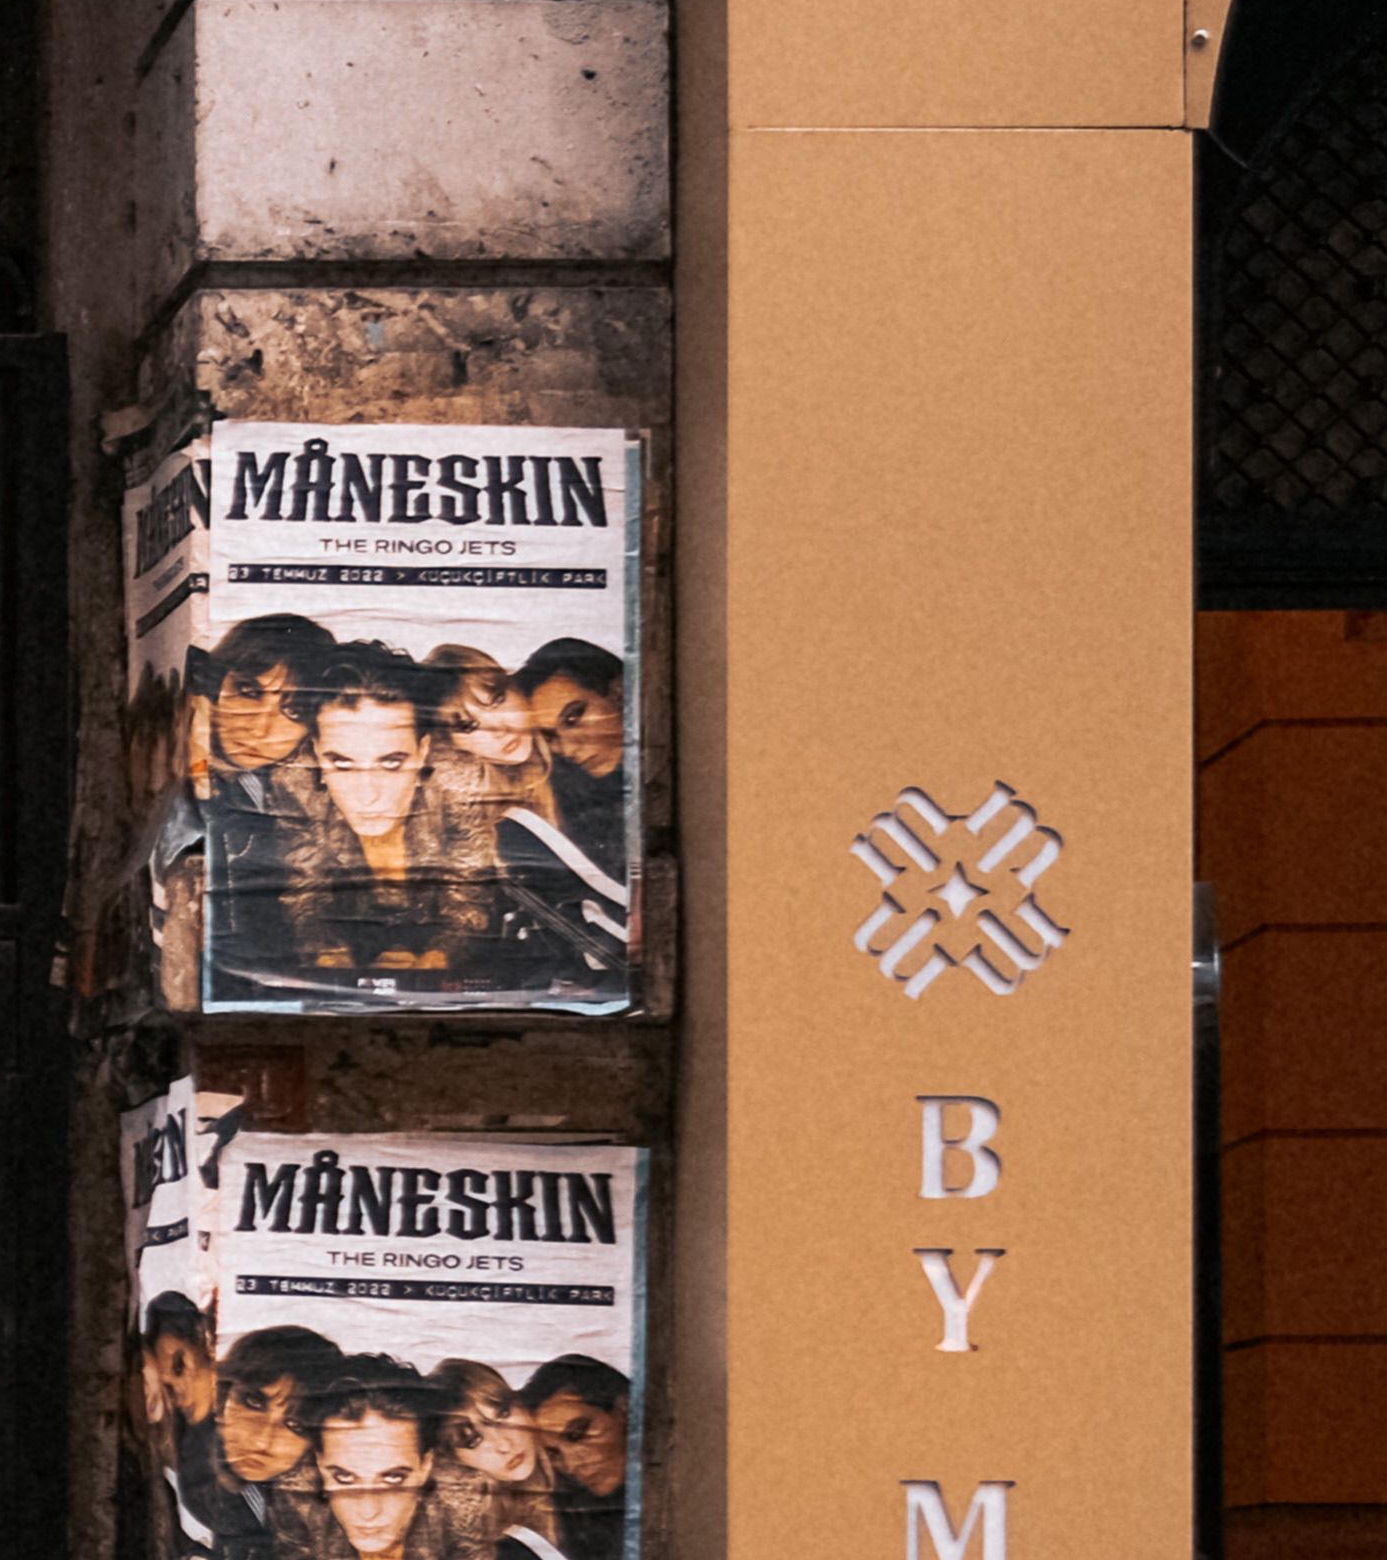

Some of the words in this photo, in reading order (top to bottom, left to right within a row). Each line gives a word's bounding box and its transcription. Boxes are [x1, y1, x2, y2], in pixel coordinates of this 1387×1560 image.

[320, 538, 368, 553] THE
[375, 539, 453, 555] RINGO
[459, 540, 517, 556] JETS
[228, 567, 248, 581] 23
[263, 568, 327, 582] TEMMUZ
[340, 569, 384, 583] 2022
[562, 572, 607, 585] PARK
[913, 1094, 1004, 1352] BY
[327, 1251, 376, 1266] THE
[383, 1253, 461, 1269] RINGO
[466, 1255, 524, 1271] JETS
[236, 1278, 257, 1291] 23
[270, 1280, 335, 1294] TEMMUZ
[347, 1282, 392, 1296] 2022
[570, 1289, 614, 1303] PARK
